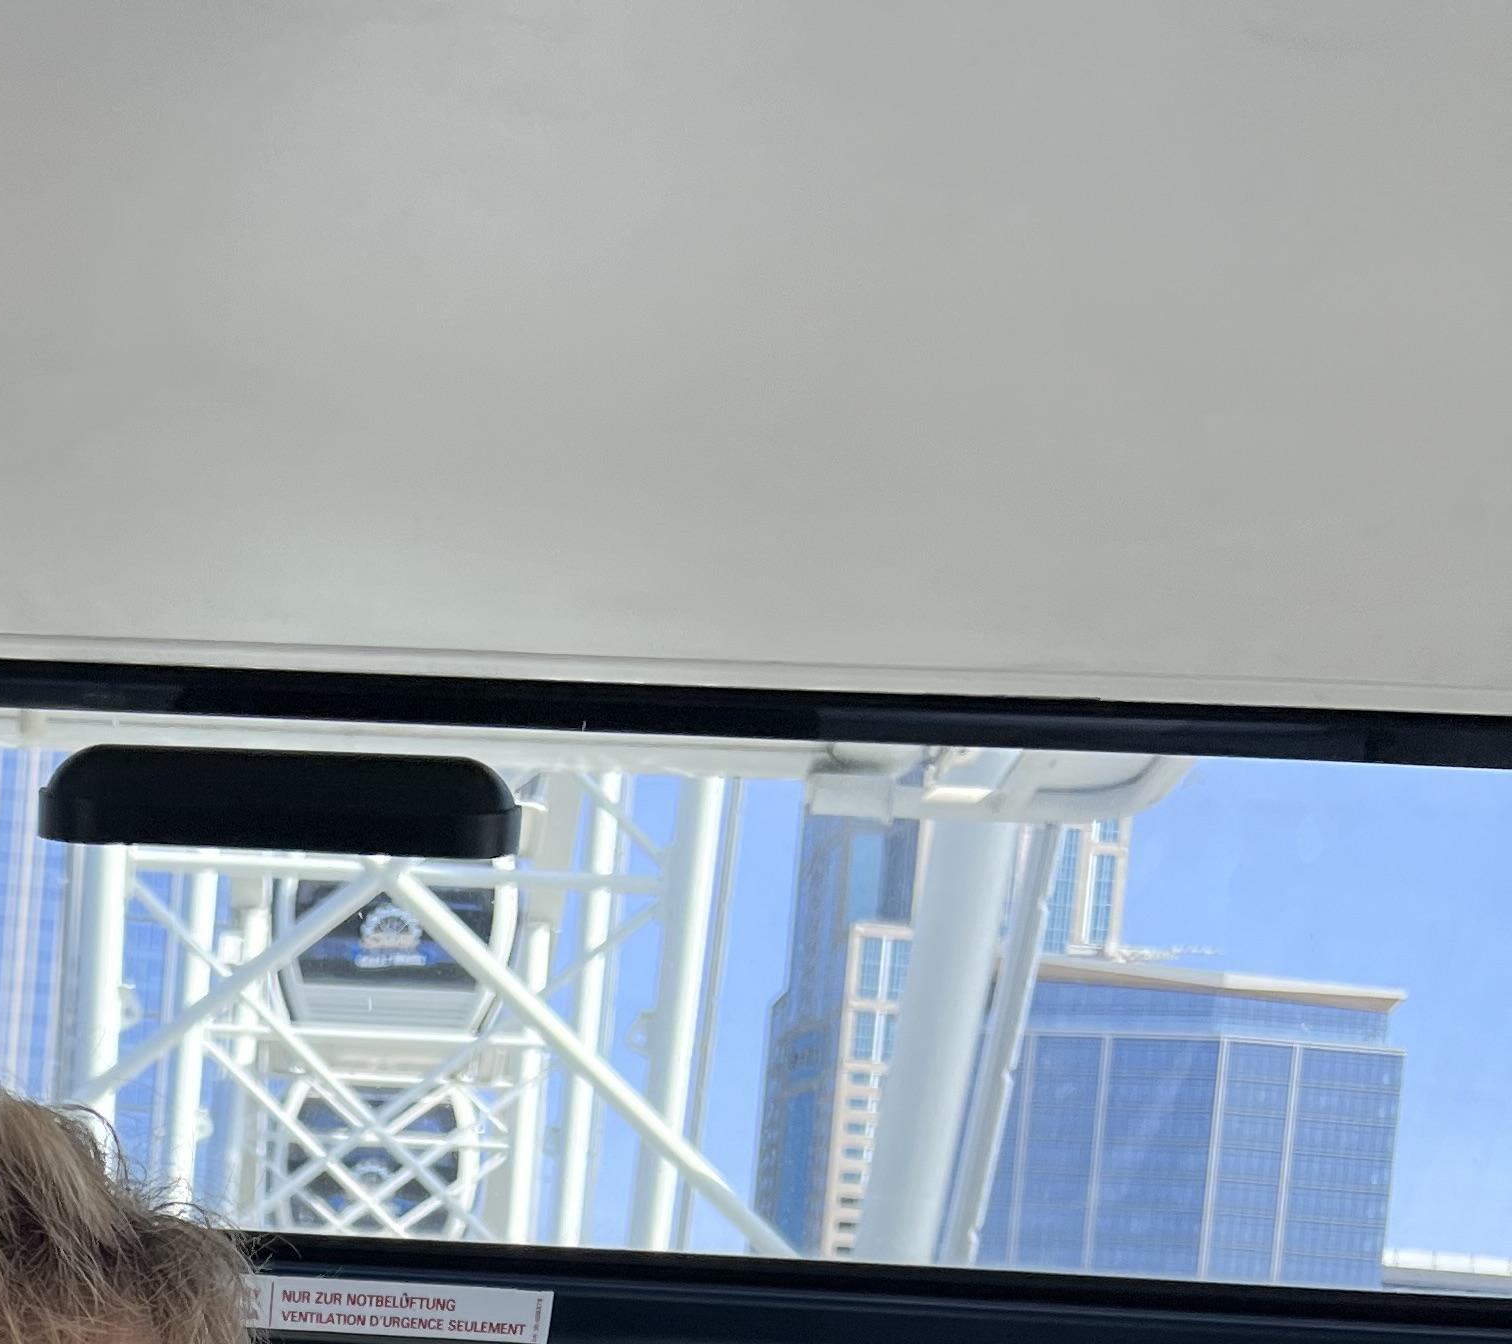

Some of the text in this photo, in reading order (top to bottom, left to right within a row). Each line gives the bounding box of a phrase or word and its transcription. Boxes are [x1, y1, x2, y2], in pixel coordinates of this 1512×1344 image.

[282, 1290, 310, 1304] NUR
[315, 1292, 342, 1306] ZUR
[281, 1311, 527, 1336] VENTILATION D'URGENCE SEULEMENT
